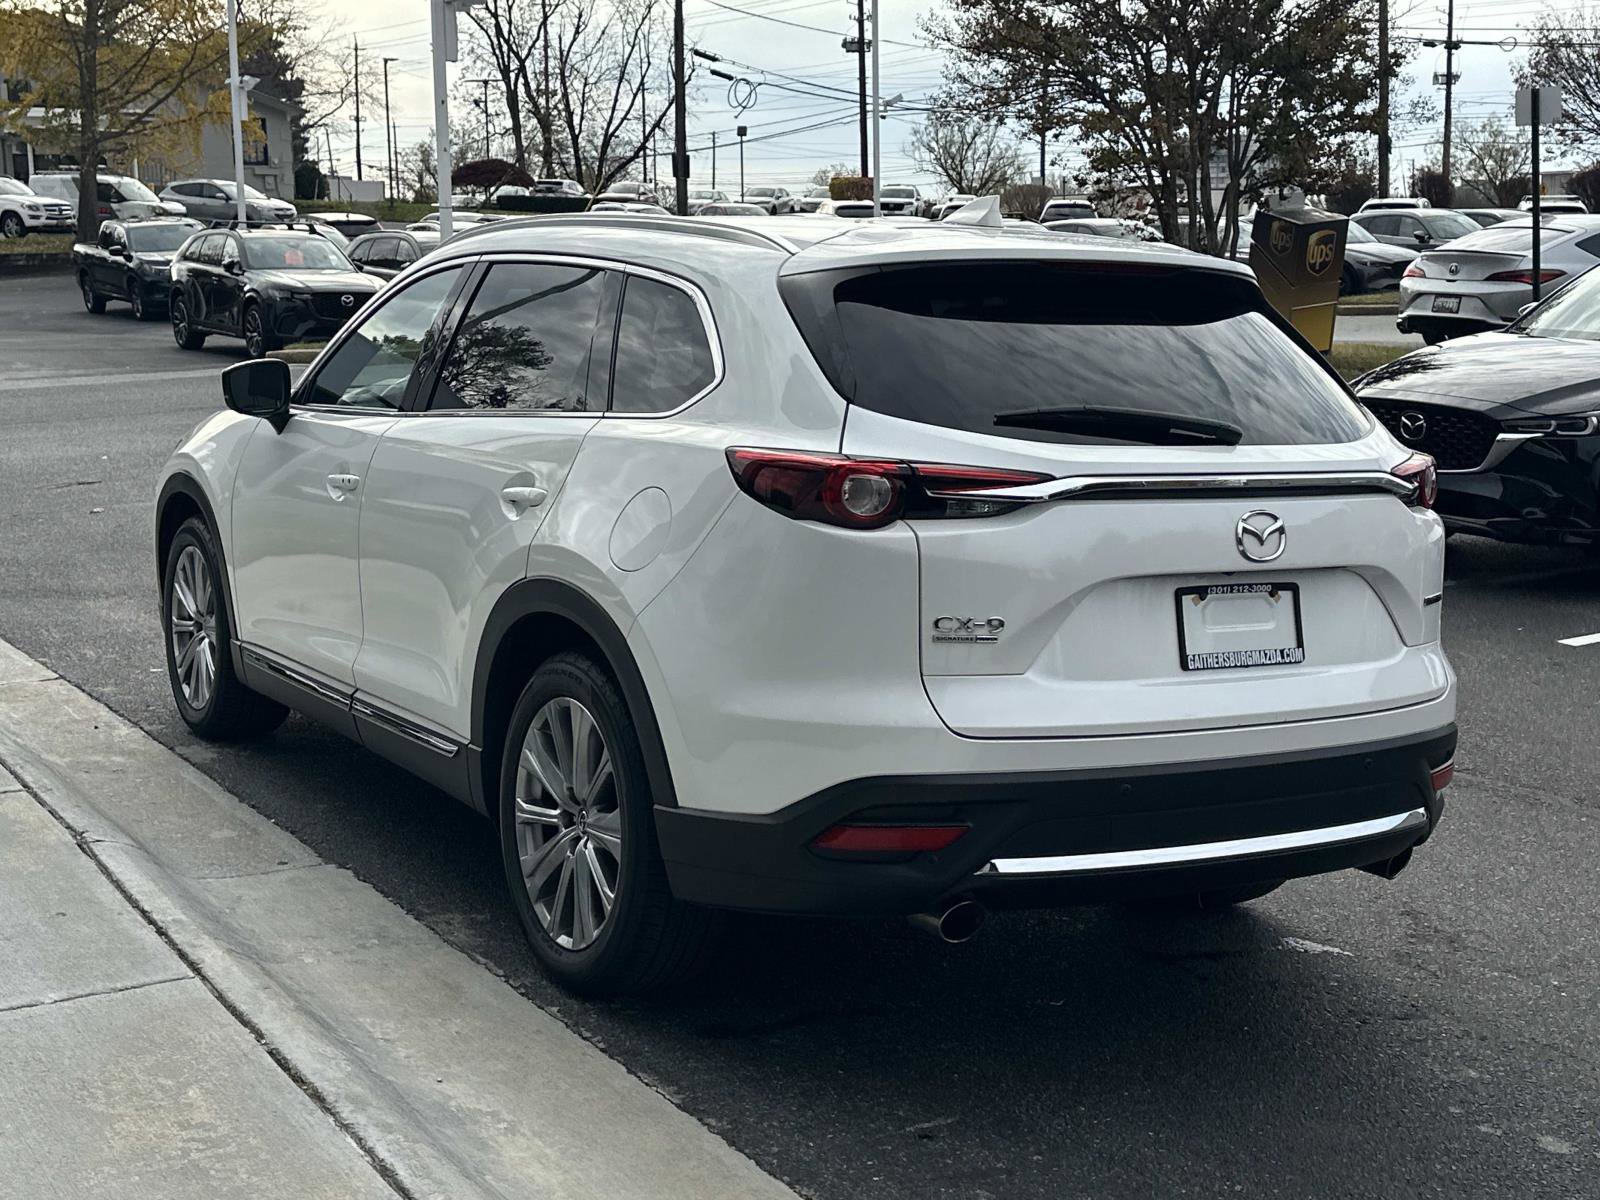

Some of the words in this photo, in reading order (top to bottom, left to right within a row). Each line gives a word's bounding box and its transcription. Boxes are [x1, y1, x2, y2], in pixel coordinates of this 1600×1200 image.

[1272, 232, 1292, 249] ups
[1309, 243, 1334, 270] ups
[1208, 586, 1231, 594] (301)
[1232, 584, 1272, 593] 212-3000
[933, 615, 1006, 633] CX-9
[1188, 648, 1304, 670] GAITHERSBURGMAZDA.COM
